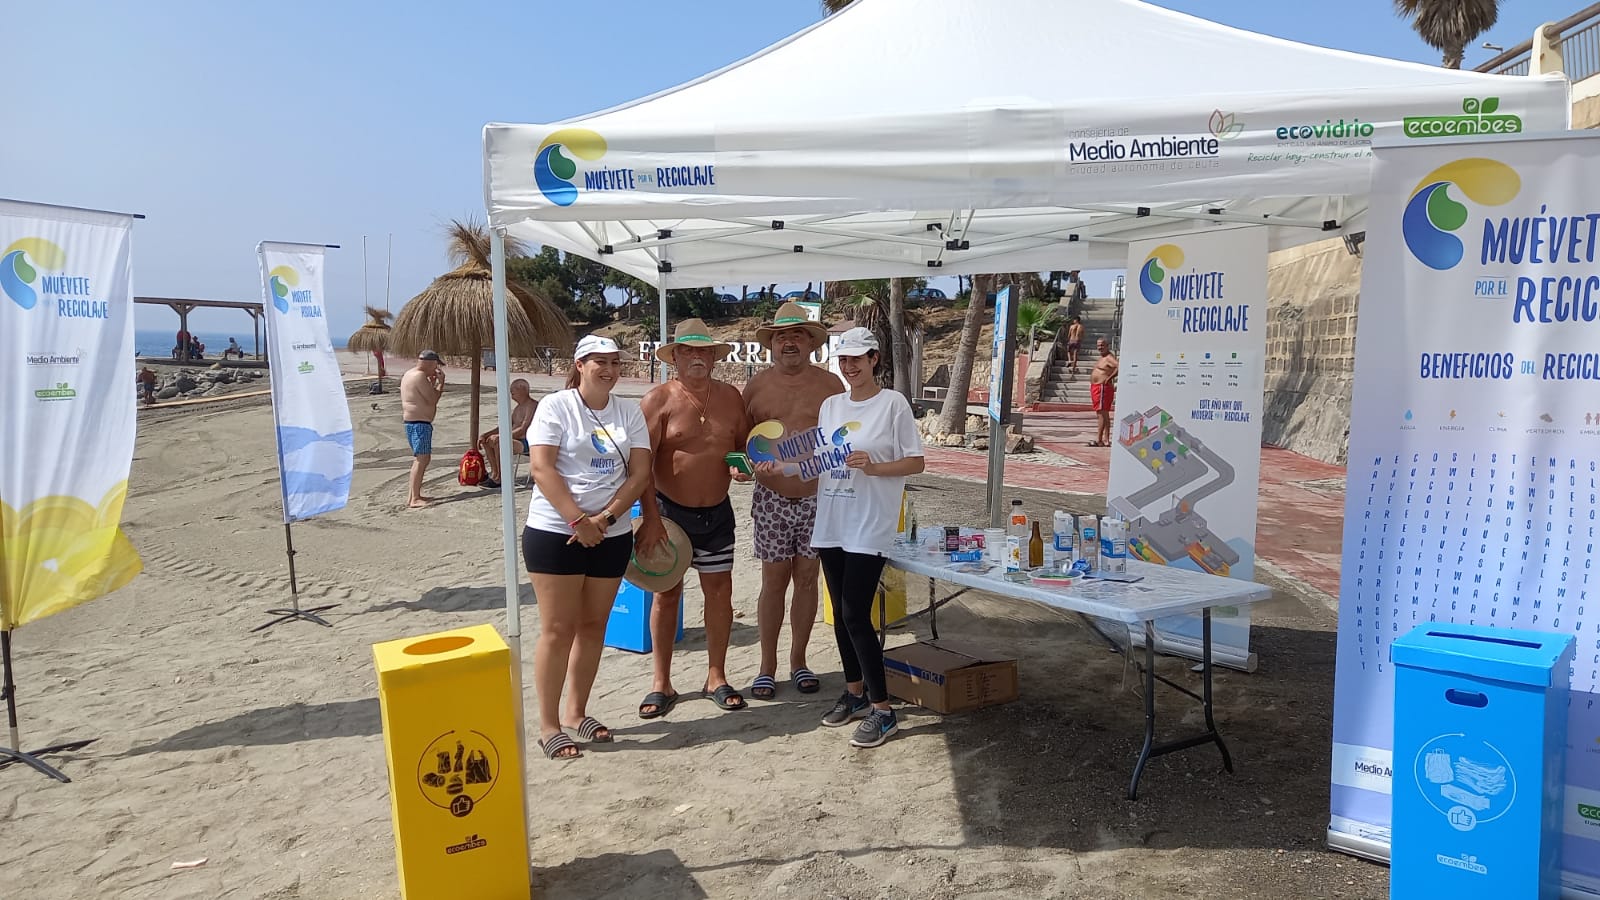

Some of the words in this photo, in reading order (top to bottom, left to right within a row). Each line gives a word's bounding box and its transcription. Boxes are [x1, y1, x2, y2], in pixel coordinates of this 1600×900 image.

[1276, 118, 1374, 139] ecovidrio
[1408, 118, 1518, 134] ecoembes
[1069, 139, 1126, 162] Medio
[1130, 136, 1219, 159] Ambiente
[584, 164, 635, 191] MUÉVETE
[656, 165, 715, 188] RECICLAJE
[42, 272, 90, 295] MUÉVETE
[1169, 268, 1225, 301] MUÉVETE
[1474, 280, 1495, 296] POR
[1497, 280, 1508, 296] EL
[58, 299, 109, 319] RECICLAJE
[1182, 304, 1249, 333] RECICLAJE
[27, 355, 49, 365] Medio
[1420, 352, 1514, 379] BENEFICIOS
[1520, 360, 1536, 374] DEL
[1354, 760, 1383, 776] Medio
